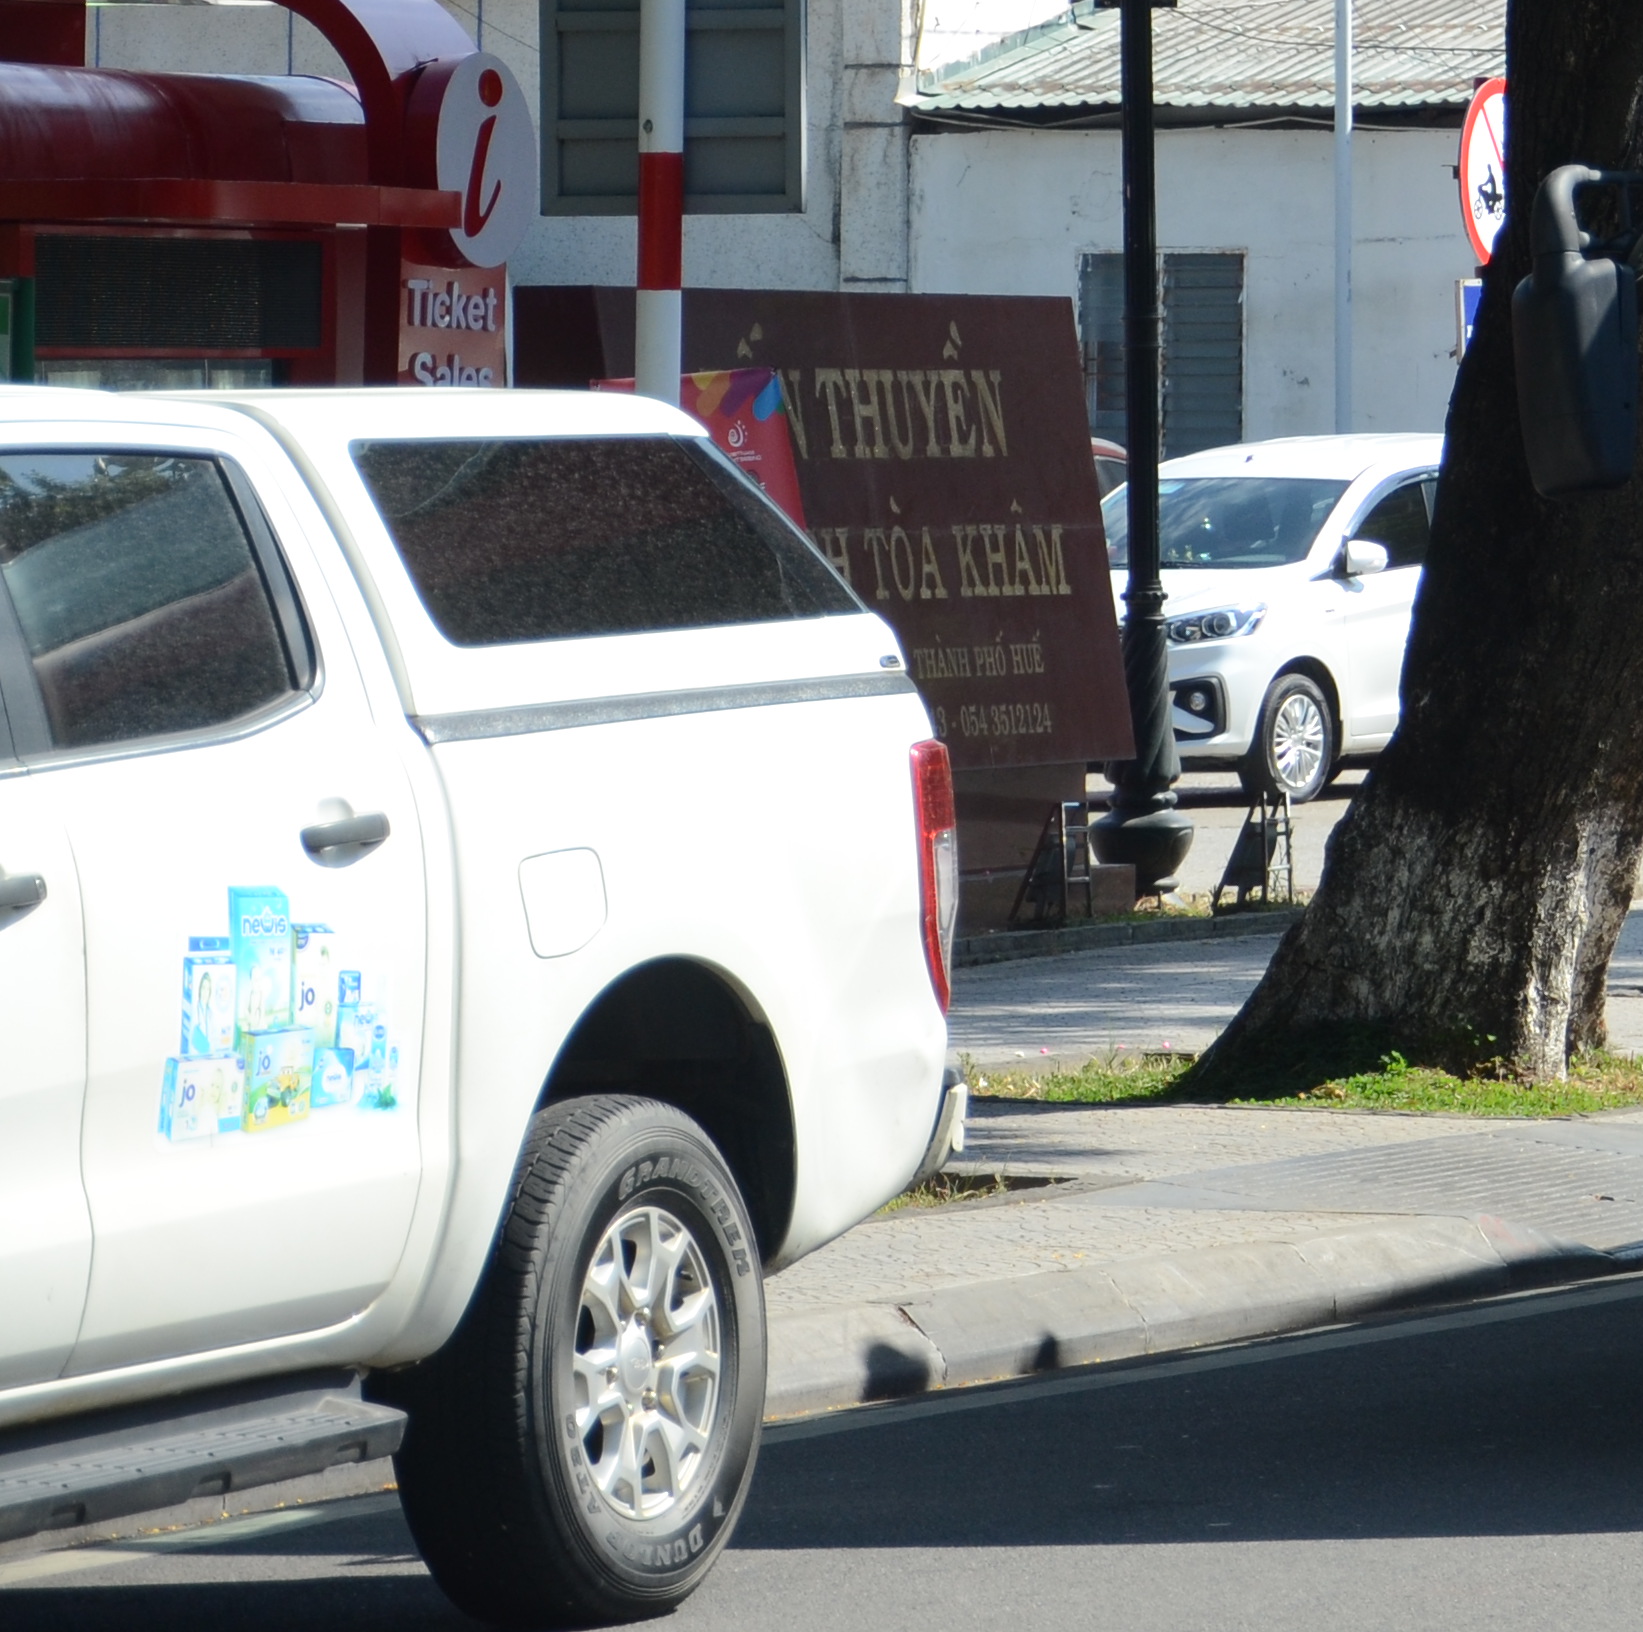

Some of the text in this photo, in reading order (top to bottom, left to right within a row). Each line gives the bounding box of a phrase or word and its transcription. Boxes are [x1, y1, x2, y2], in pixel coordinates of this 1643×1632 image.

[407, 278, 498, 332] Ticket
[815, 320, 1009, 460] THUYỀN
[863, 495, 949, 601] TÒA
[952, 497, 1072, 597] KHÂM
[913, 629, 1045, 679] THÀNH PHỐ HUẾ
[960, 705, 988, 737] 054
[618, 1156, 751, 1277] GRANDTREK
[605, 1522, 704, 1566] DUNLOP
